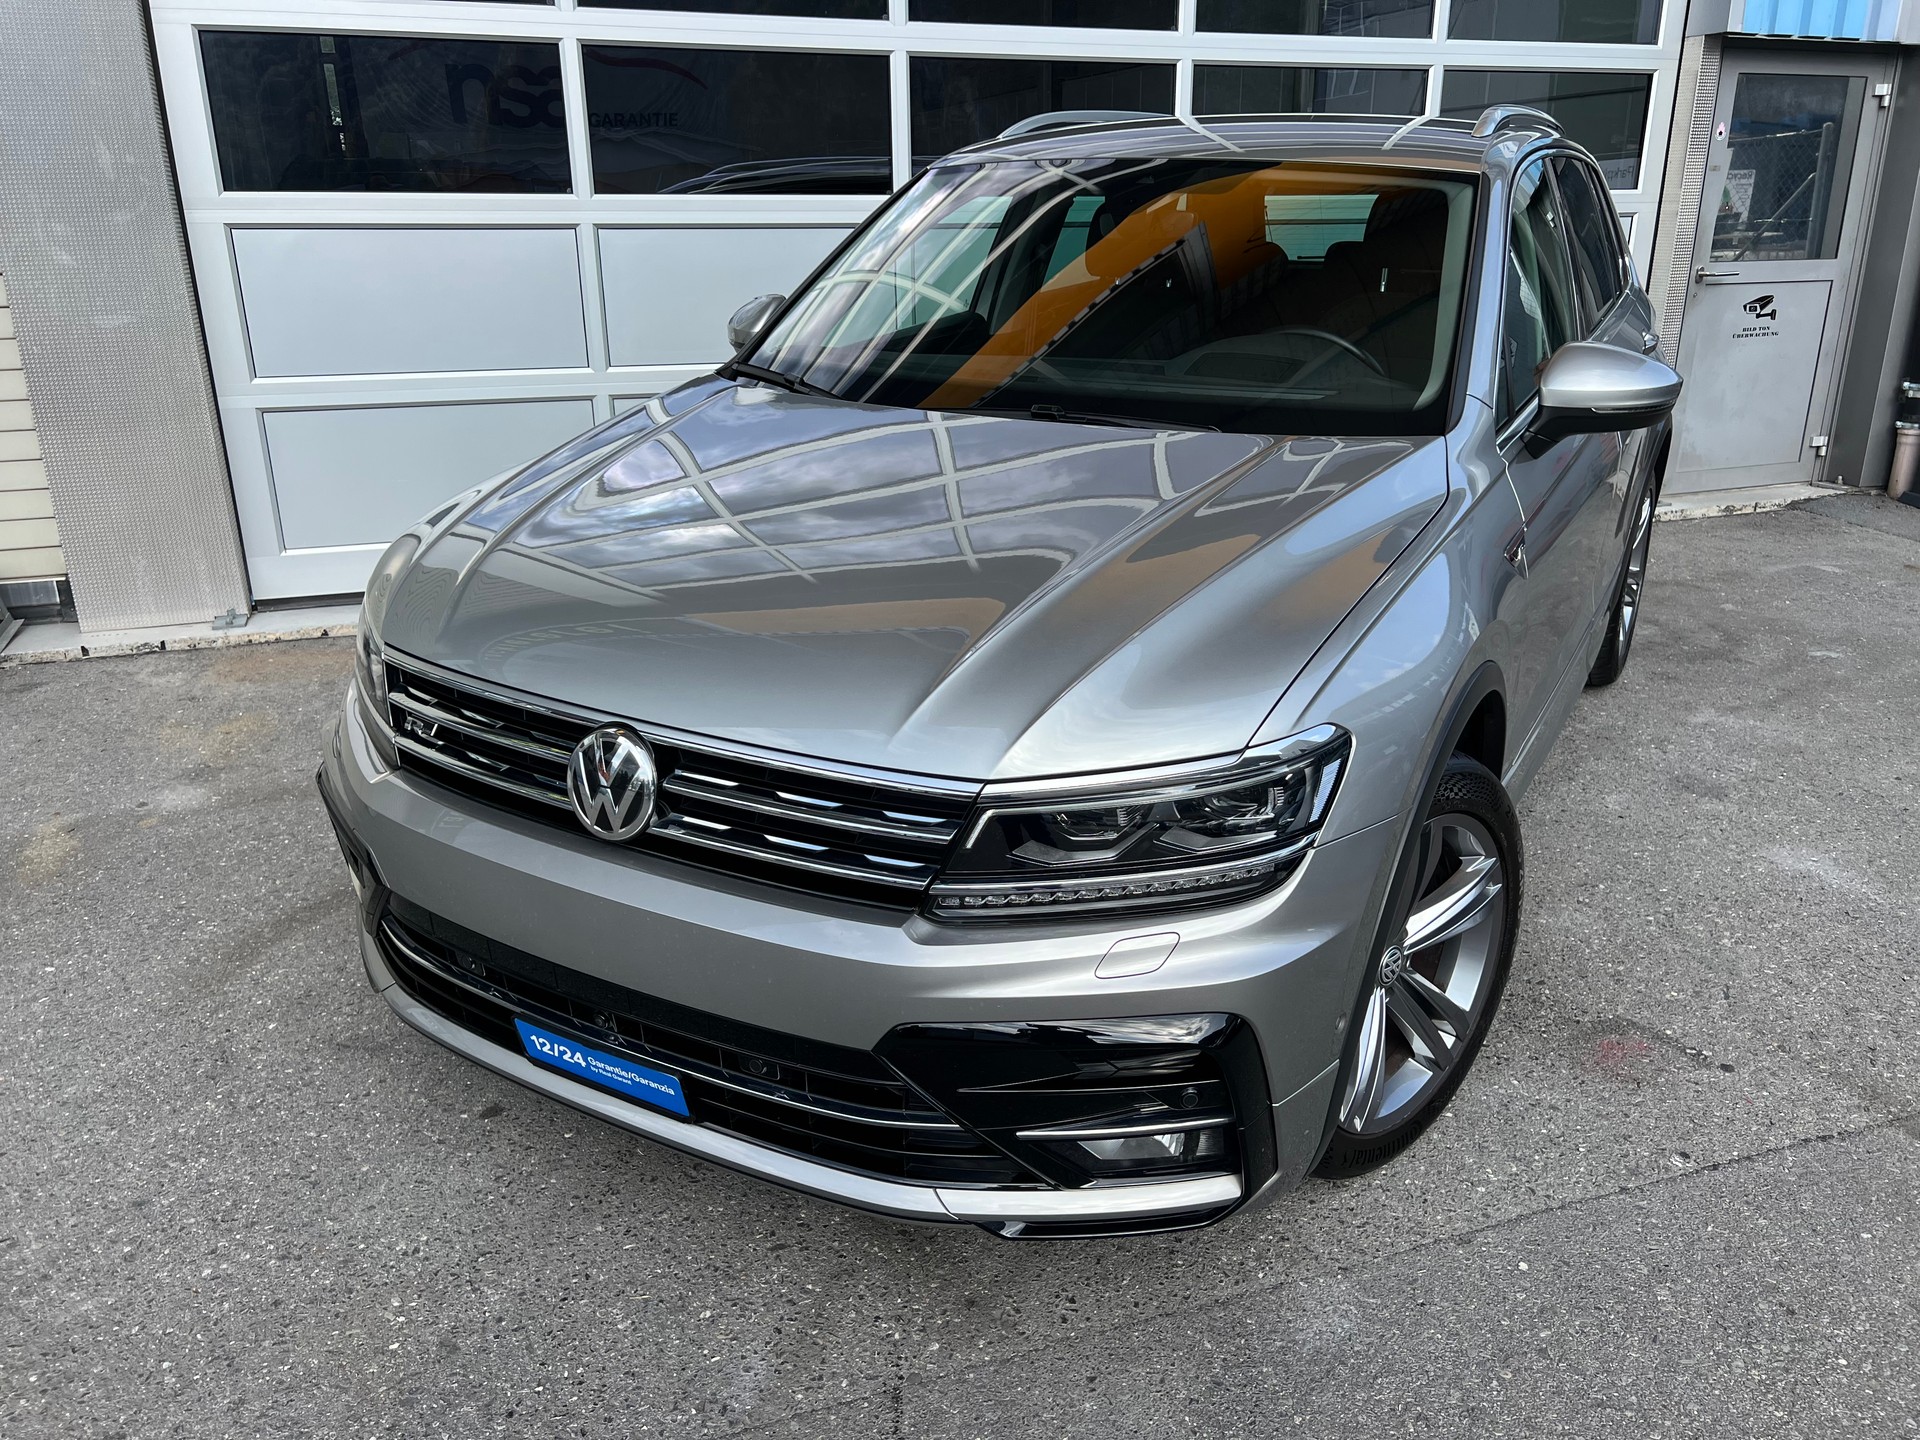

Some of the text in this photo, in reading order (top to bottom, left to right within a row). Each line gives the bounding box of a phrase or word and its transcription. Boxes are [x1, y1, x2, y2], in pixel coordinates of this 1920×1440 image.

[589, 112, 678, 128] GARANTIE
[567, 728, 657, 841] VW
[530, 1034, 676, 1096] 12/24 Garantie/Garanzia
